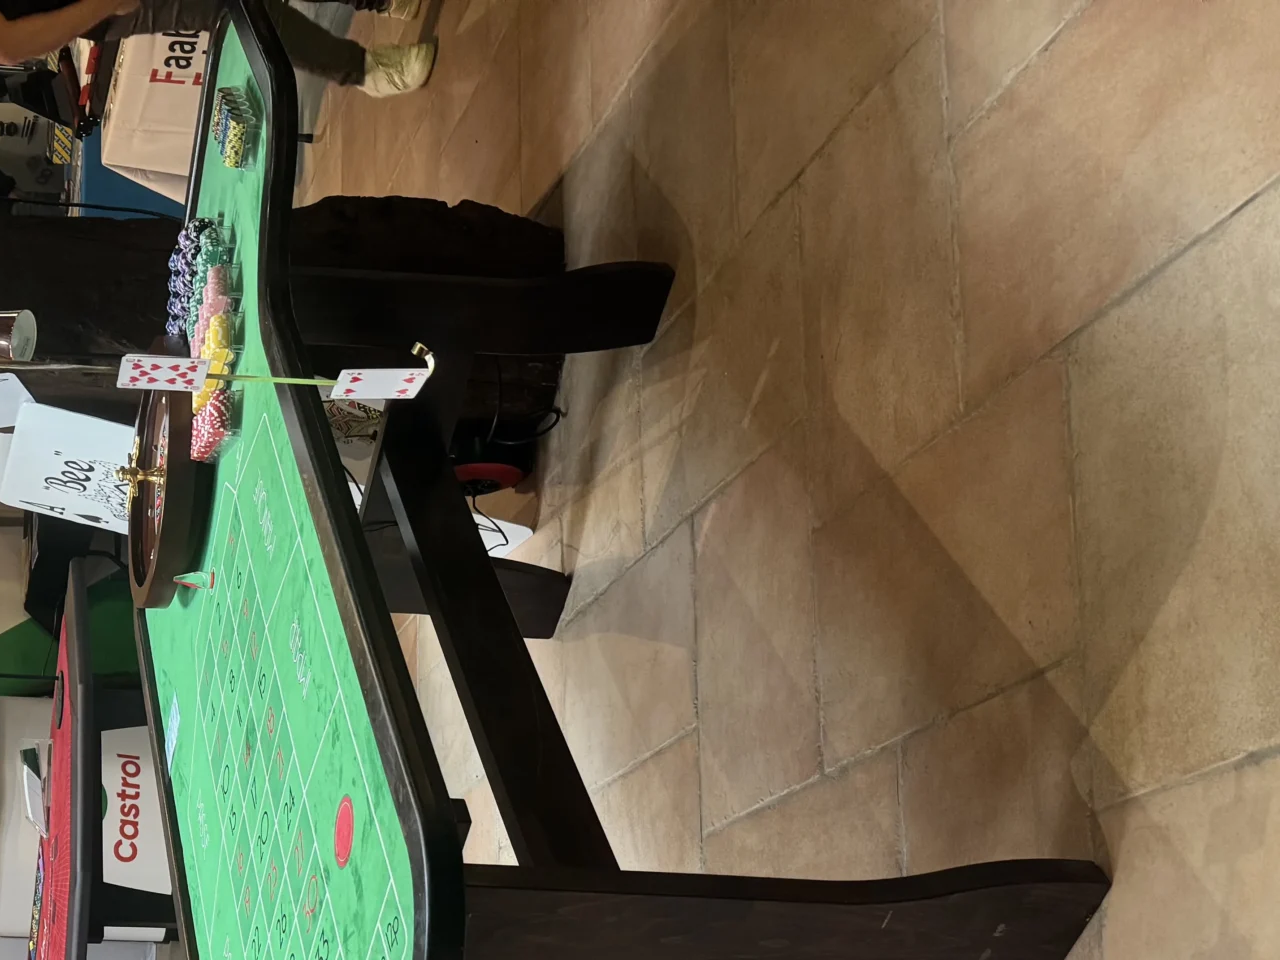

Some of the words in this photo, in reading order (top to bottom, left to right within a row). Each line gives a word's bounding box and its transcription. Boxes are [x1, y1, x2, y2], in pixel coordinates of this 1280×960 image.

[19, 500, 65, 516] A
[220, 764, 230, 803] 10
[113, 753, 141, 863] Castrol
[283, 785, 296, 832] 24
[256, 811, 270, 864] 20
[276, 903, 287, 950] 26
[302, 875, 319, 934] 30
[385, 916, 399, 952] 12p
